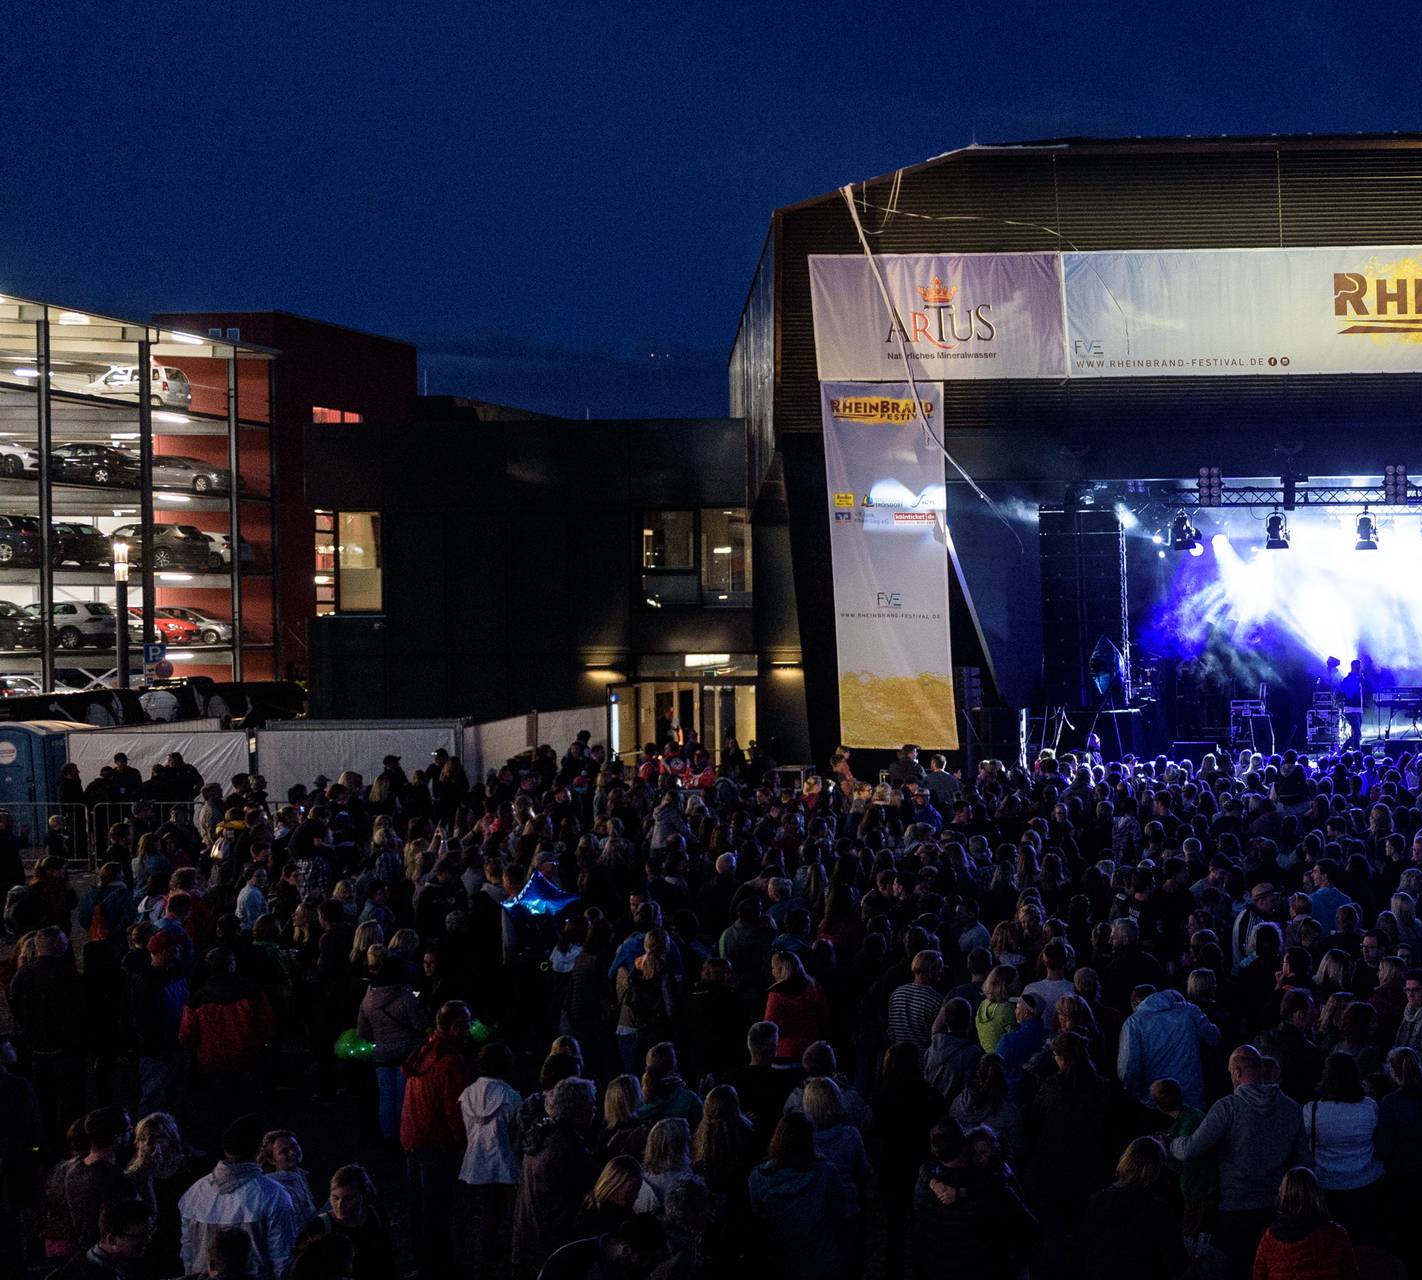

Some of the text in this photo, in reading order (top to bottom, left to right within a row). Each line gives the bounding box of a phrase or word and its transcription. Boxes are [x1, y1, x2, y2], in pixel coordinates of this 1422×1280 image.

[885, 303, 997, 350] ARTUS
[1074, 340, 1104, 355] FVE
[887, 350, 998, 361] Natrliches Mineralwasser
[880, 413, 934, 421] FESTIVL
[877, 592, 902, 606] FVE
[149, 646, 161, 661] P
